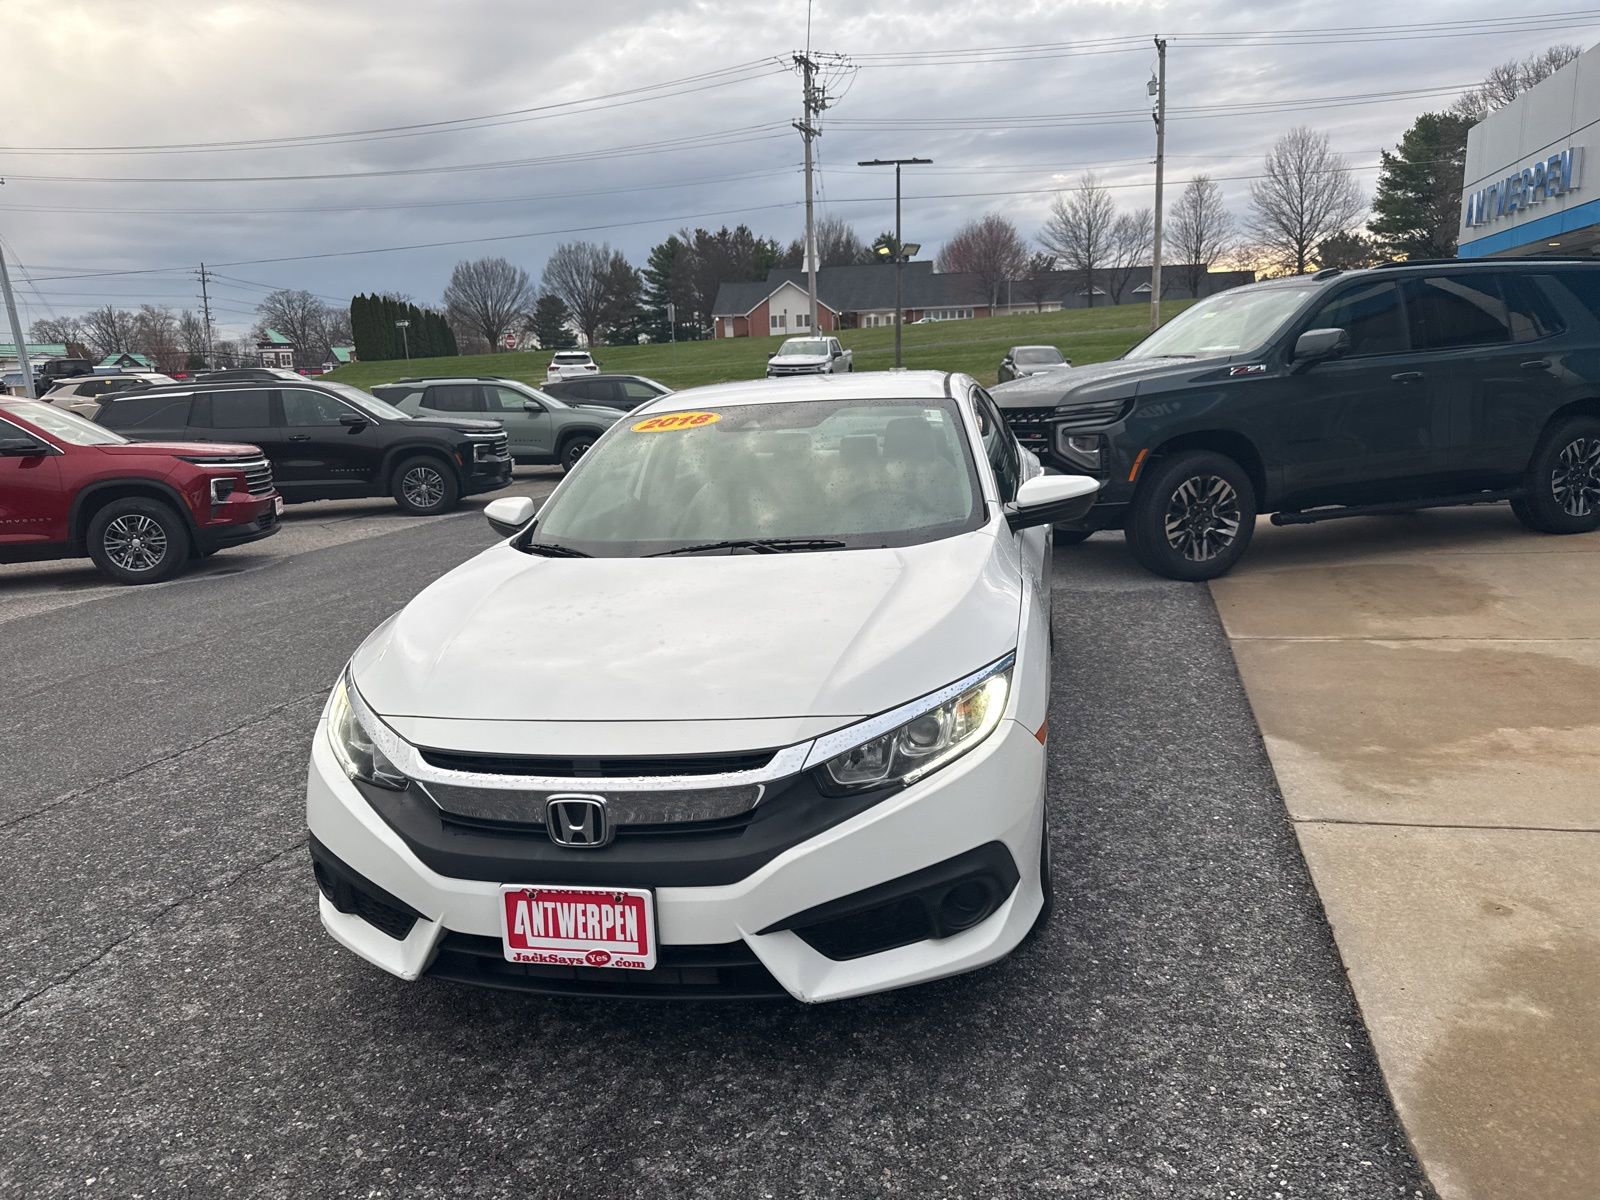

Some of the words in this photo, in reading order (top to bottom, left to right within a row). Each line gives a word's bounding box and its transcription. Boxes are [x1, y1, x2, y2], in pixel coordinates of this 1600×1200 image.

[1465, 146, 1584, 228] ANTWERPEN
[638, 414, 714, 431] 2018
[514, 900, 638, 942] ANTWERPEN
